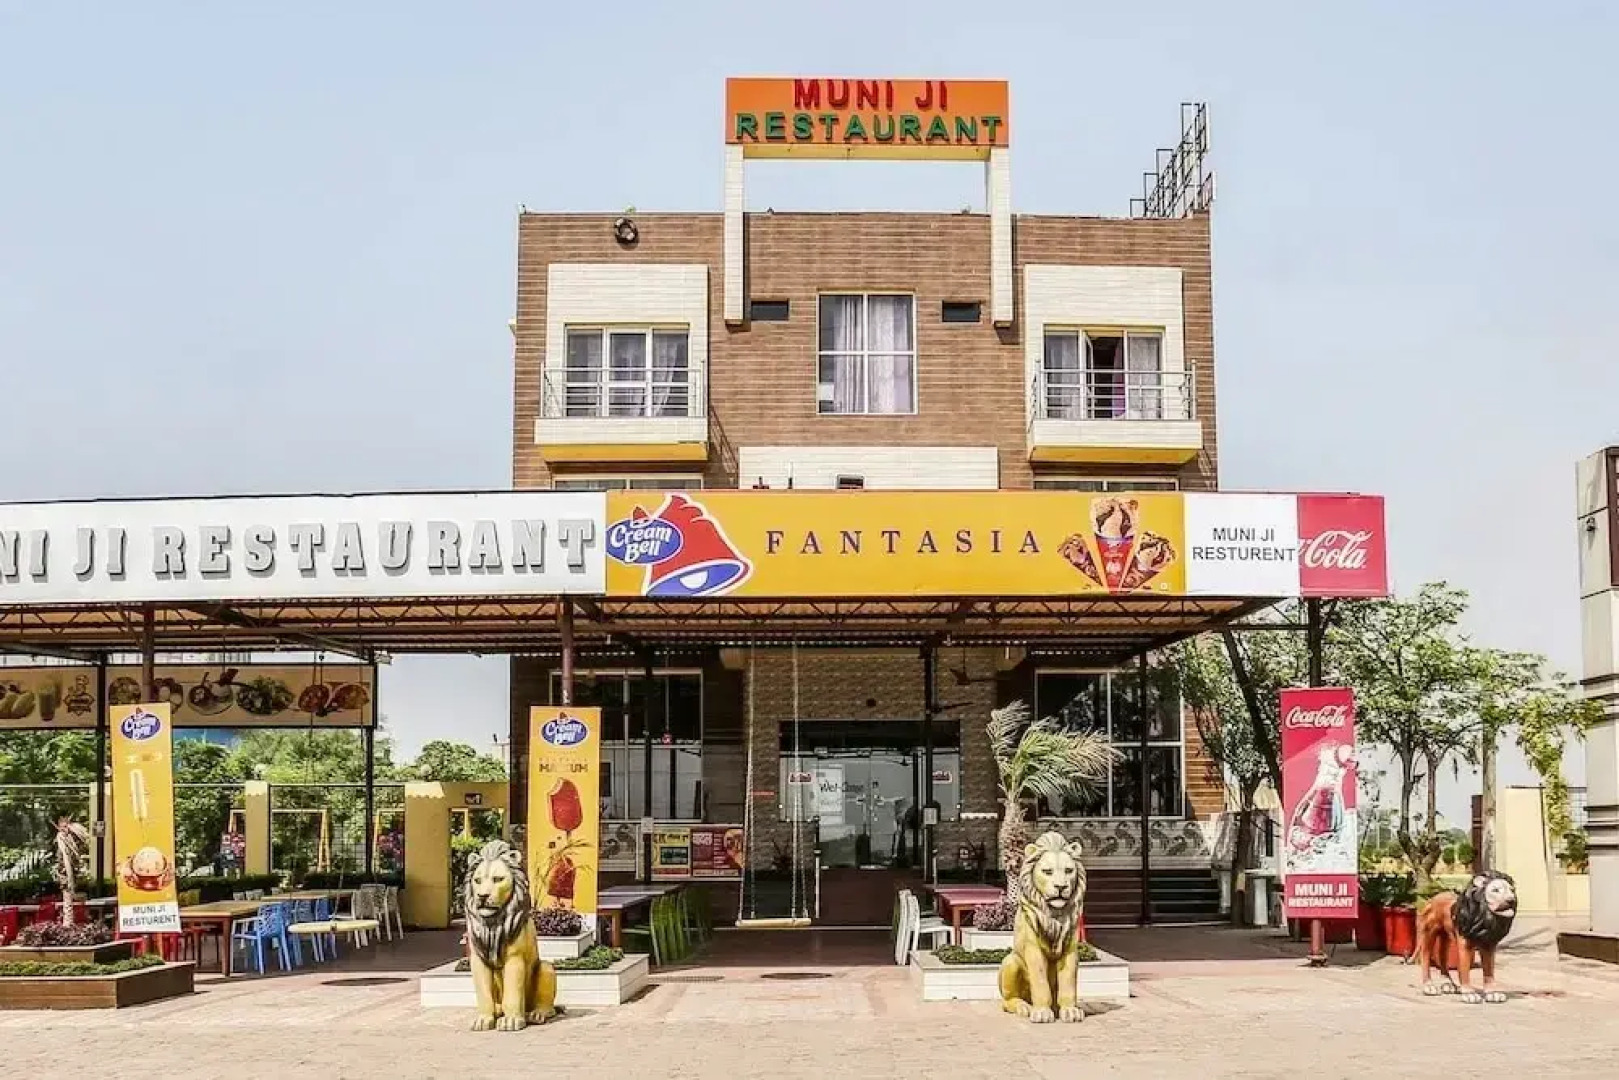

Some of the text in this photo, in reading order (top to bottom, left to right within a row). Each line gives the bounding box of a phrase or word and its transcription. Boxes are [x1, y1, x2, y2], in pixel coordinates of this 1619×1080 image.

[794, 79, 949, 111] MUNI JI
[735, 112, 1002, 144] RESTAURANT
[610, 525, 673, 548] Cream
[766, 530, 1041, 555] FANTASIA
[1212, 527, 1275, 542] MUNI JI
[74, 527, 126, 581] JI
[152, 517, 597, 581] RESTAURANT
[624, 540, 662, 563] Bell
[1192, 546, 1296, 562] RESTURENT
[1285, 705, 1349, 729] Coca-Cola
[1294, 883, 1348, 896] MUNI JI
[1288, 897, 1354, 908] RESTAURANT
[122, 914, 177, 927] RESTURENT
